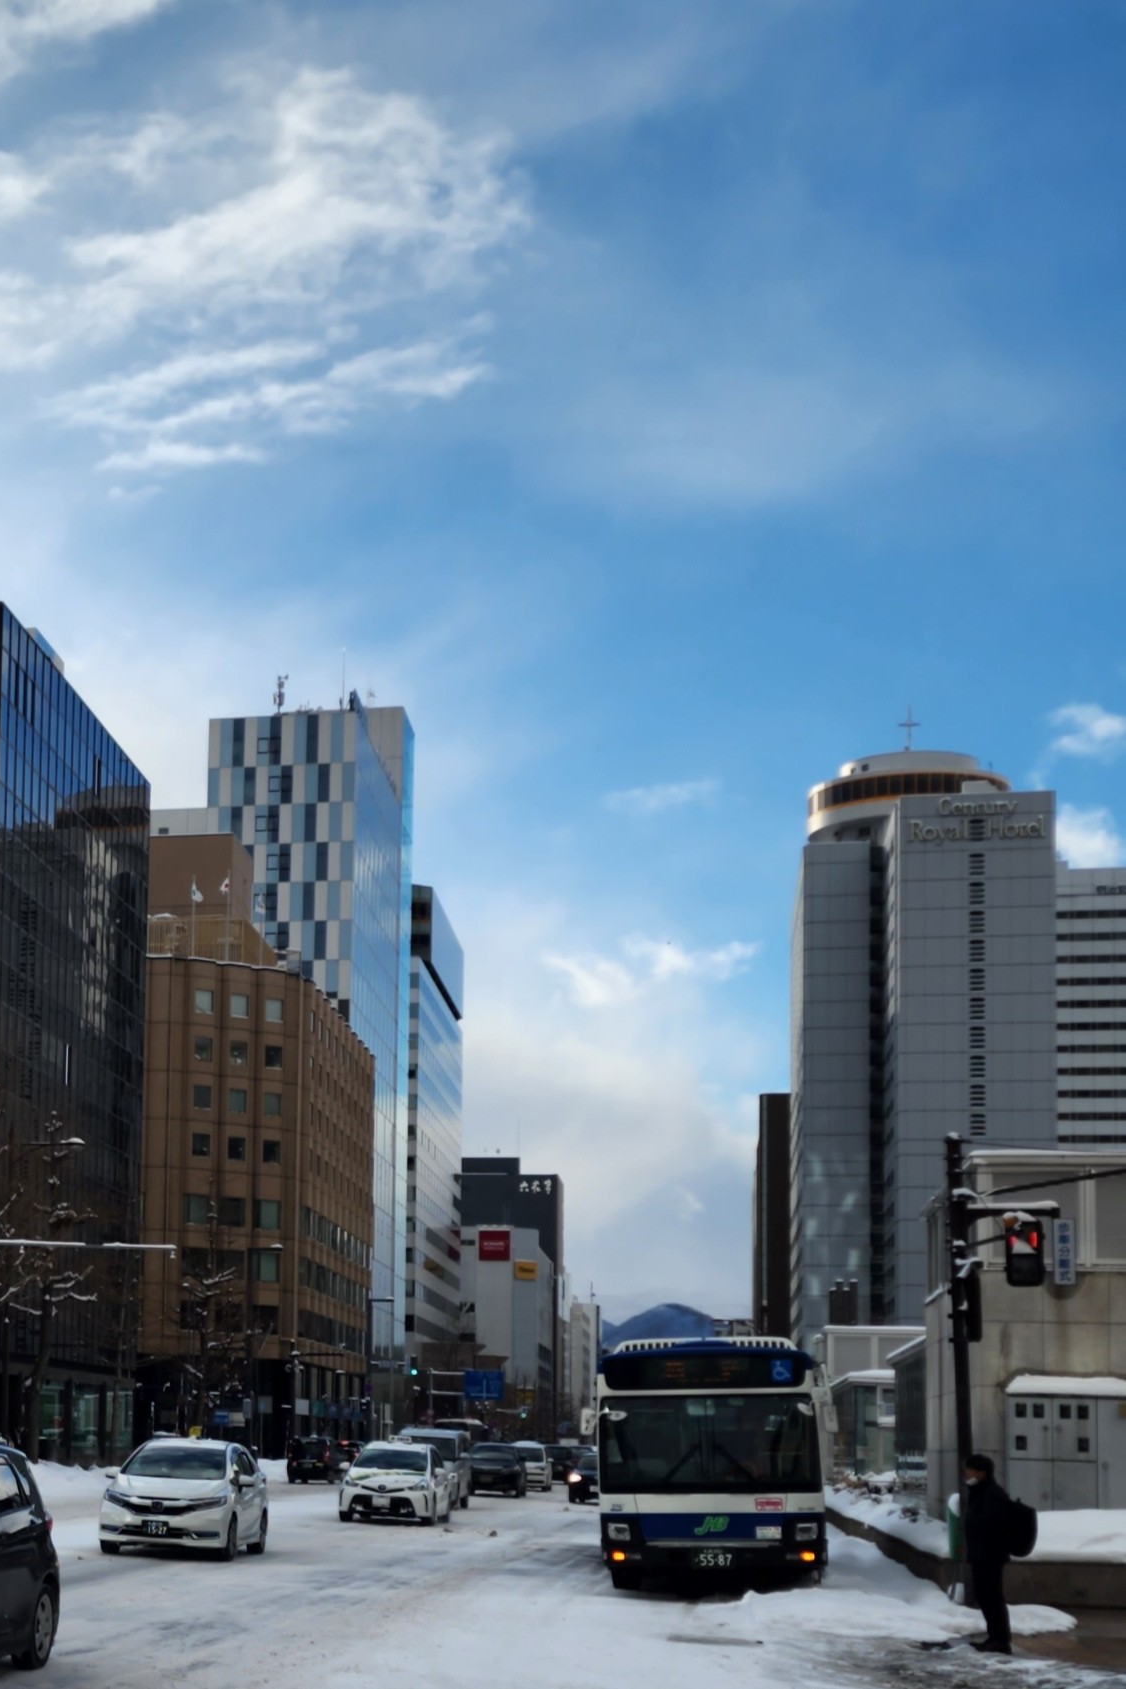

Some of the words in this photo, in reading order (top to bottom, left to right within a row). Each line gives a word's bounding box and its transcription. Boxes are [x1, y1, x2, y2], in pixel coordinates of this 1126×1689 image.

[938, 797, 1017, 819] Century
[909, 818, 969, 846] Royal
[986, 815, 1046, 839] Hotel
